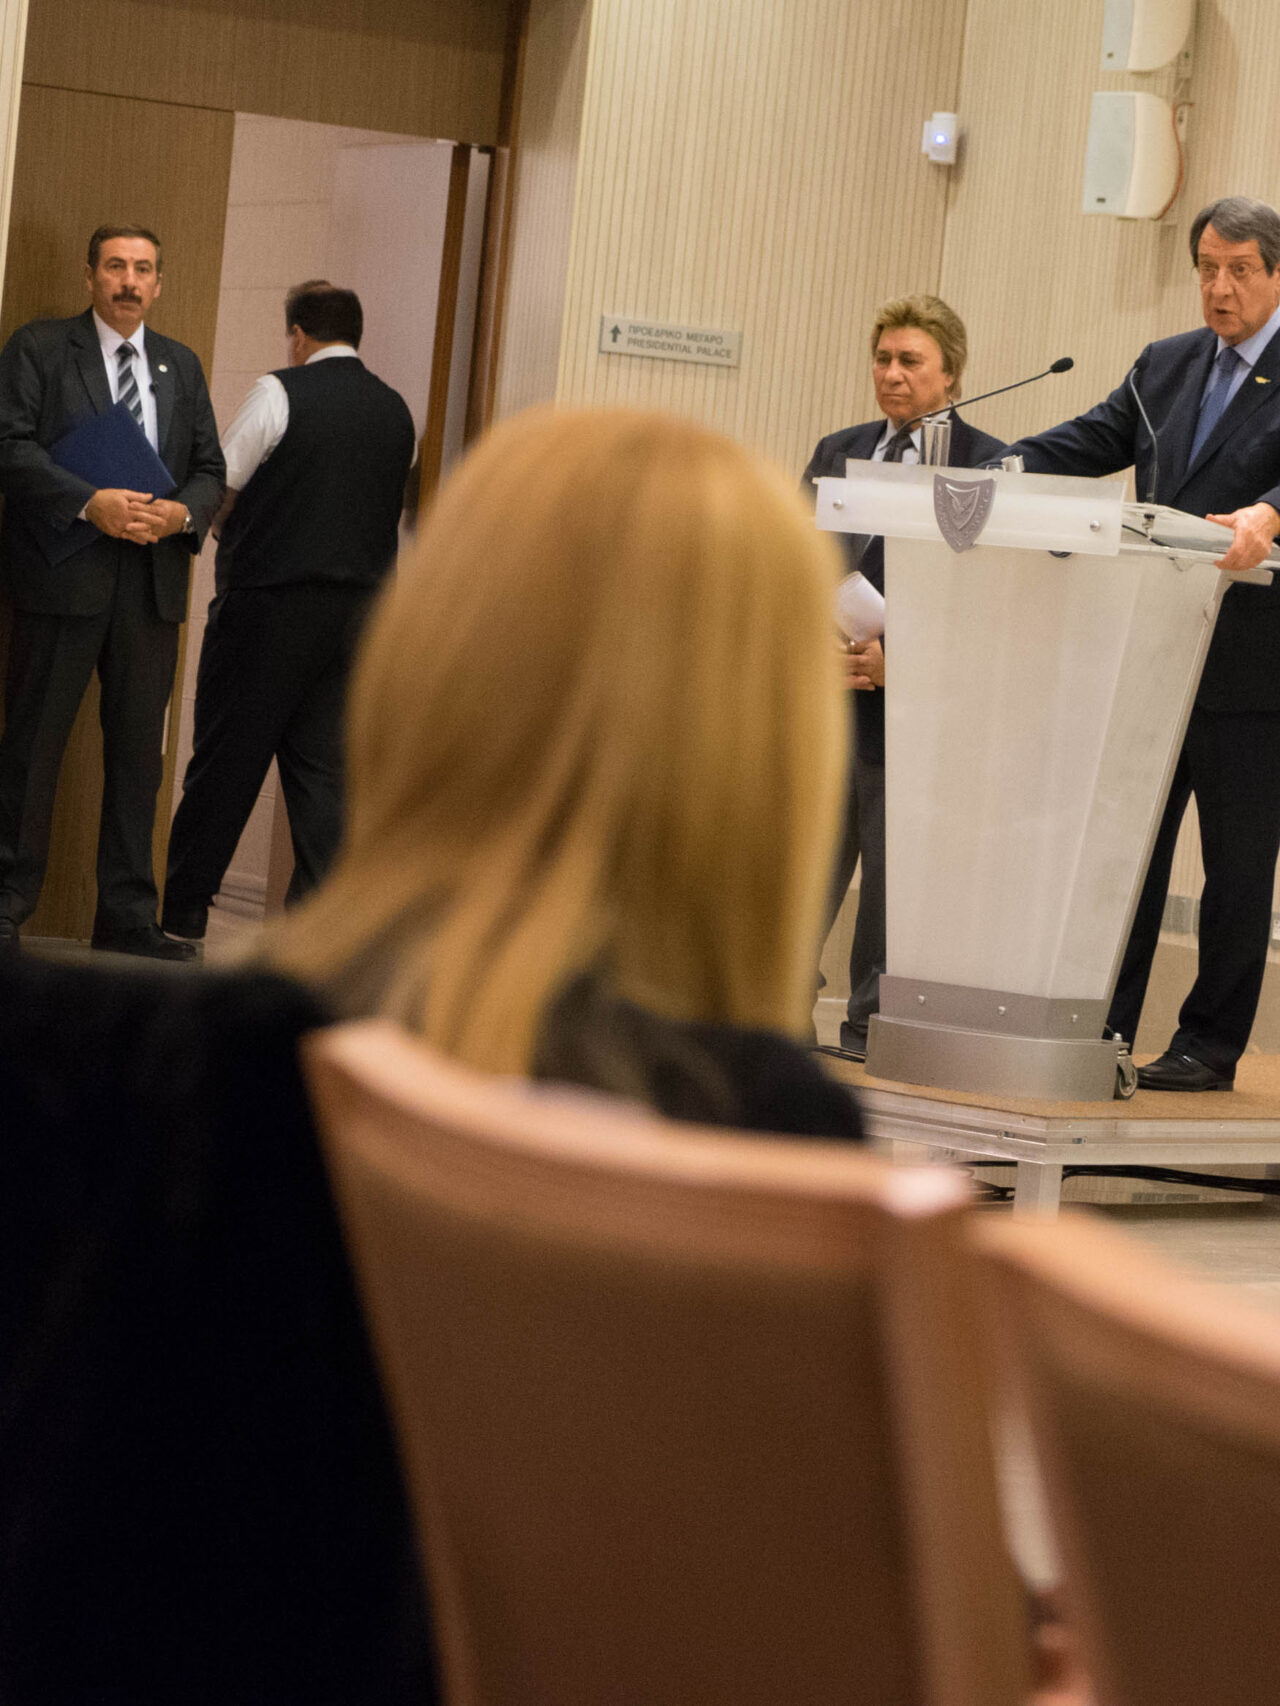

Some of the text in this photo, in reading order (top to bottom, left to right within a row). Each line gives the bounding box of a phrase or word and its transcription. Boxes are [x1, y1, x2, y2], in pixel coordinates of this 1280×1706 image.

[628, 325, 724, 345] ΠΡΟΕΔΡΙΚΟ ΜΕΓΑΡΟ
[627, 338, 732, 359] PRESIDENTIAL PALACE
